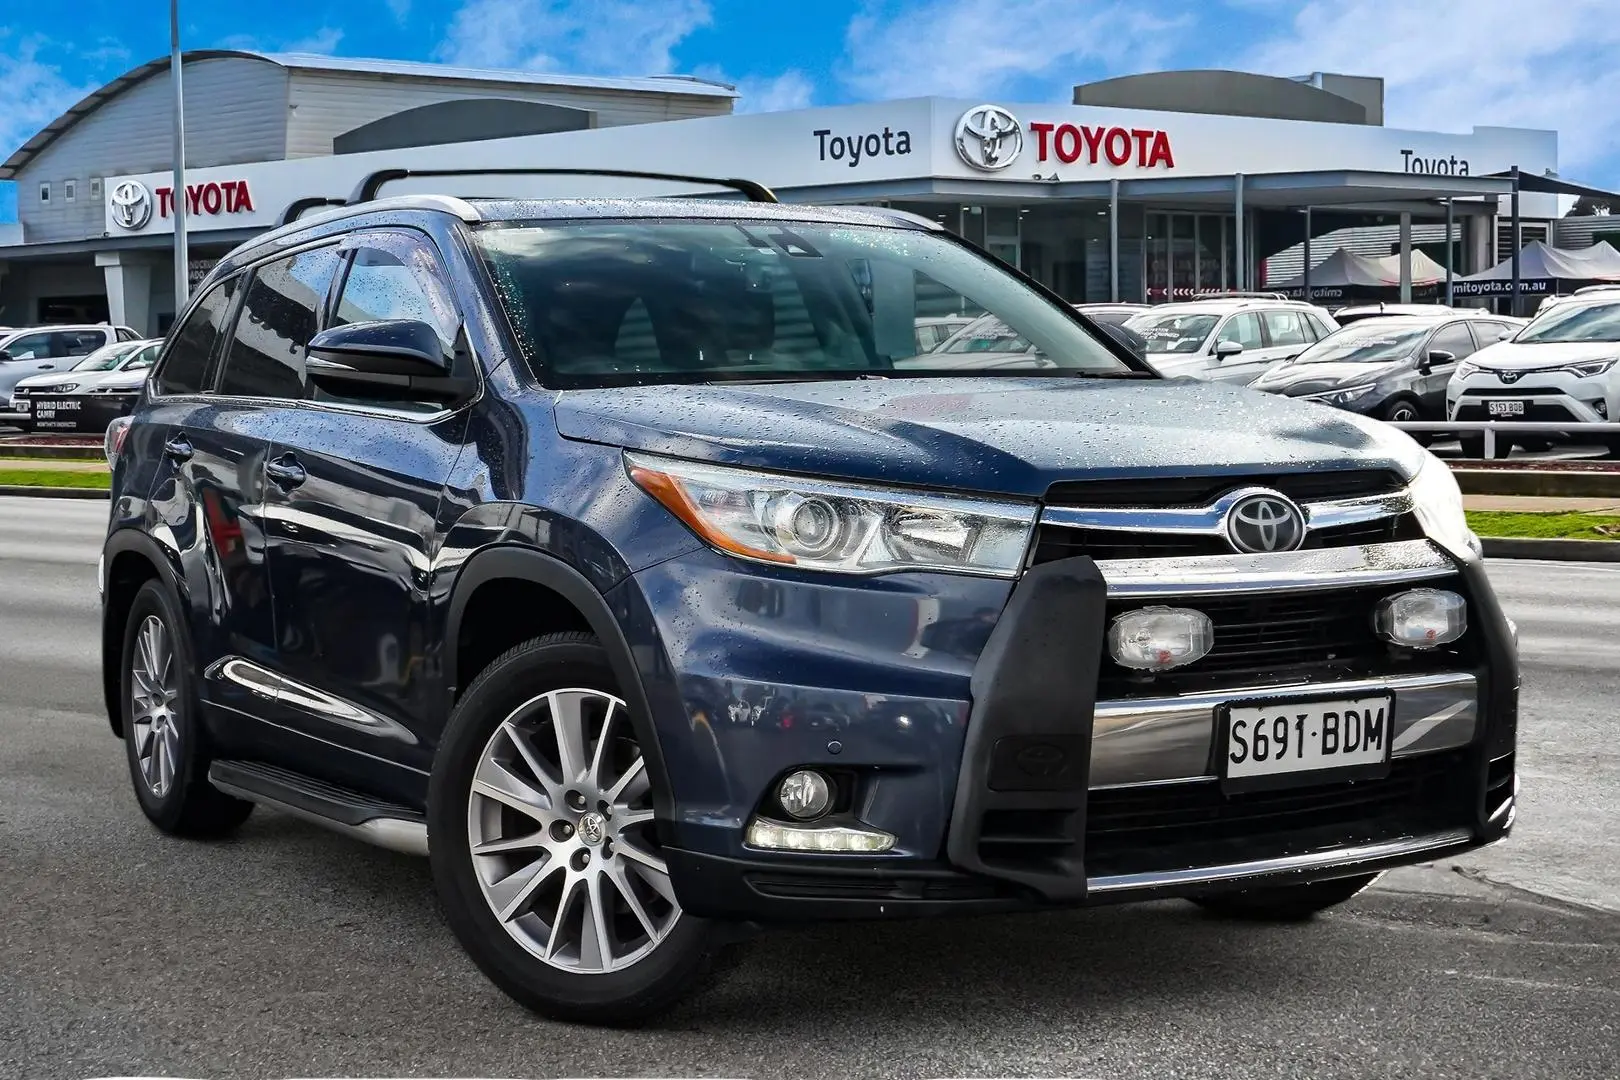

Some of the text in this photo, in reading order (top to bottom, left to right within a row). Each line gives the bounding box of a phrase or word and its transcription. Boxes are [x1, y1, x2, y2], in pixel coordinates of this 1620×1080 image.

[813, 127, 911, 167] Toyota
[1030, 122, 1175, 168] TOYOTA
[1400, 149, 1469, 176] Toyota
[1453, 281, 1546, 294] mitoyota.cm.au
[36, 401, 56, 410] HYBRID
[57, 401, 81, 410] ELECTRIC
